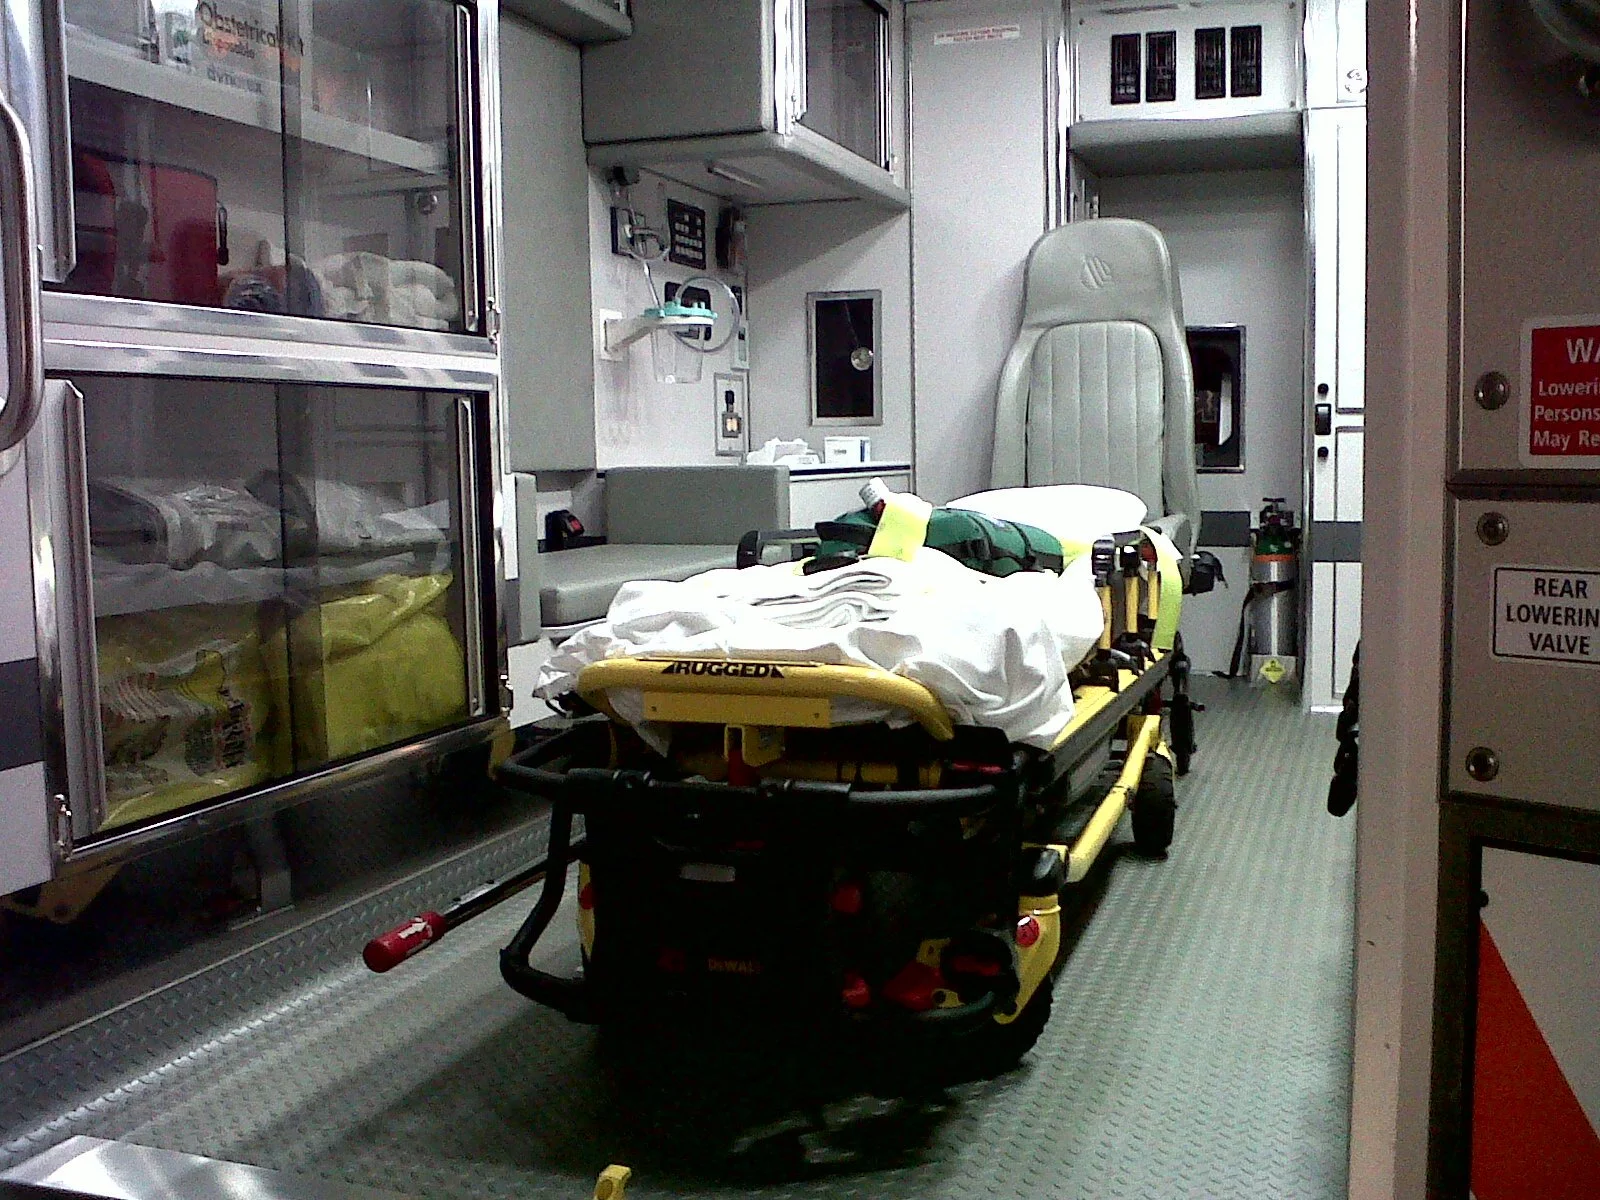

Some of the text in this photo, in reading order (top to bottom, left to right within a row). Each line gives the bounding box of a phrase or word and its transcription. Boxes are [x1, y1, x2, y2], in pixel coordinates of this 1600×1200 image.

[199, 1, 280, 49] Obstetrical
[1539, 377, 1600, 397] Loweri
[1534, 405, 1600, 422] Persons
[1533, 430, 1600, 451] May Re
[1533, 577, 1588, 600] REAR
[1506, 603, 1600, 628] LOWERIN
[1529, 632, 1590, 656] VALVE
[675, 661, 770, 678] RUGGED
